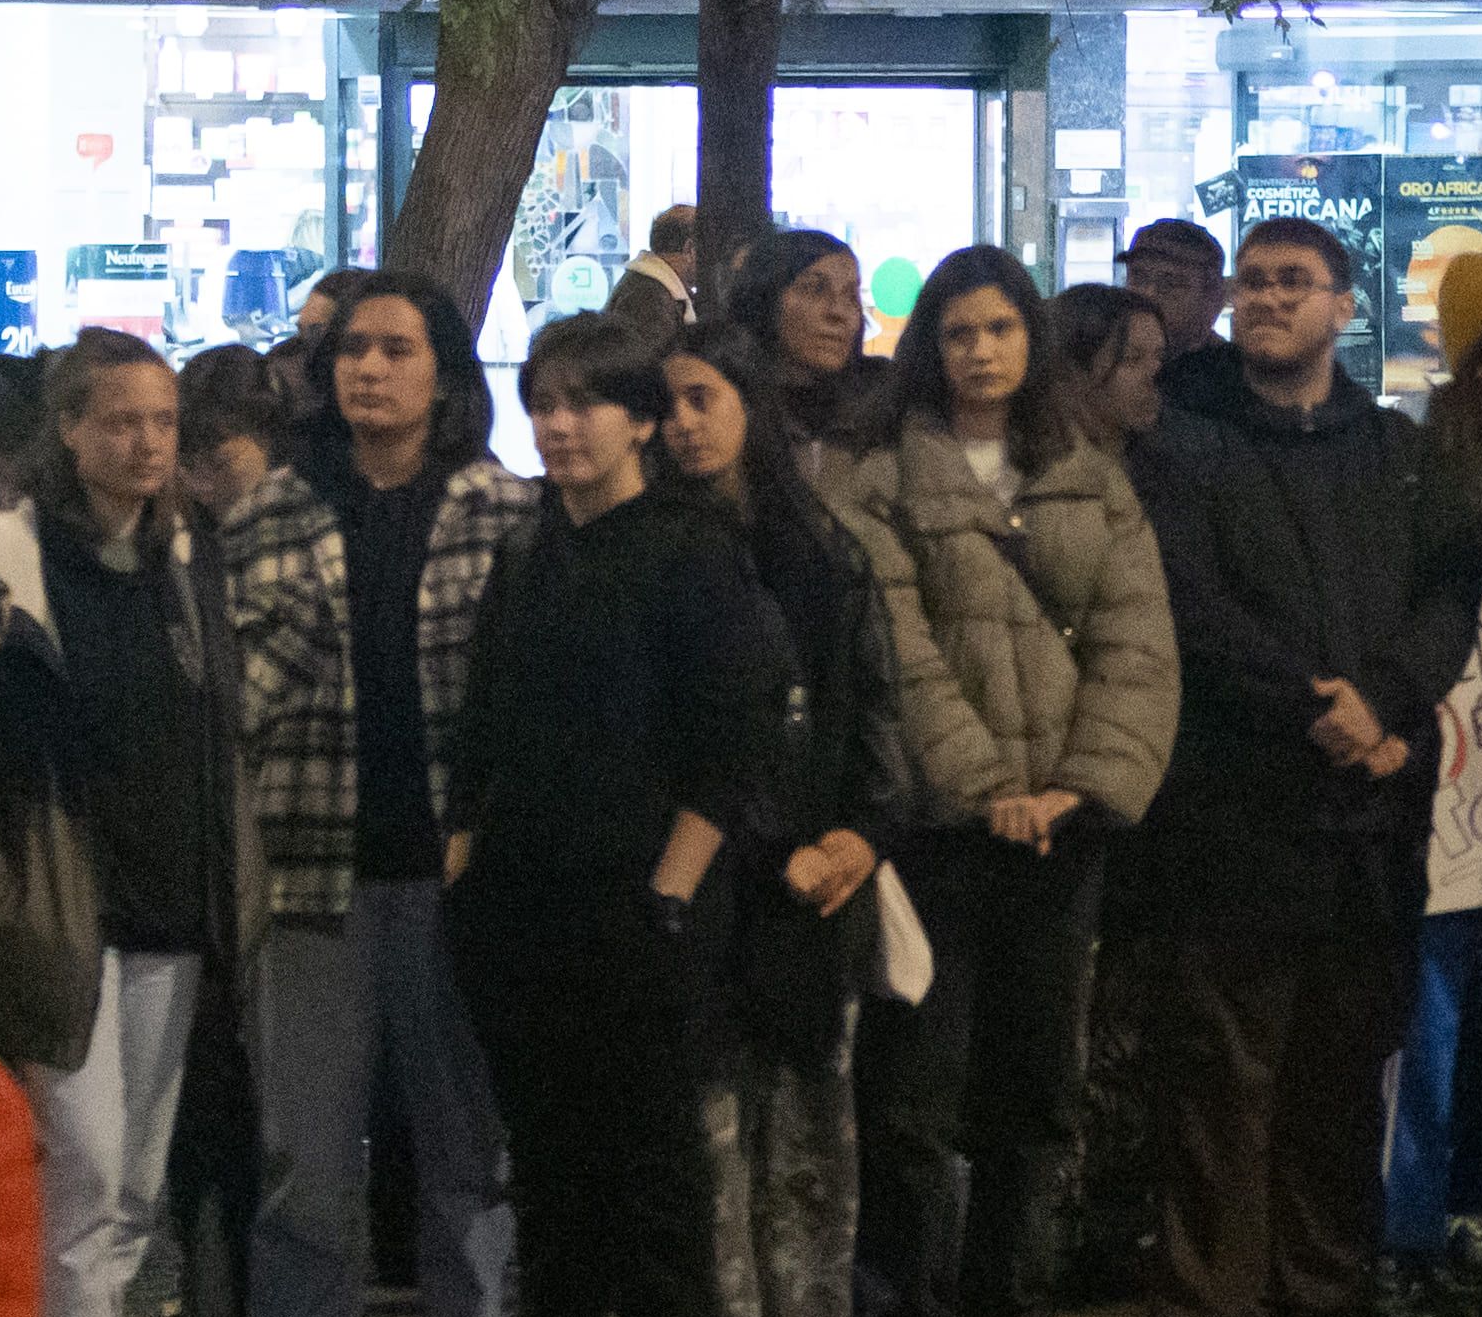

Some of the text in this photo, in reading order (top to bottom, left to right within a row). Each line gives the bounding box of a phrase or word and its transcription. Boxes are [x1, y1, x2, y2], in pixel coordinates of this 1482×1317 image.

[1247, 185, 1320, 199] COSMÉTICA
[1399, 182, 1433, 196] ORO
[1243, 198, 1373, 222] AFRICANA
